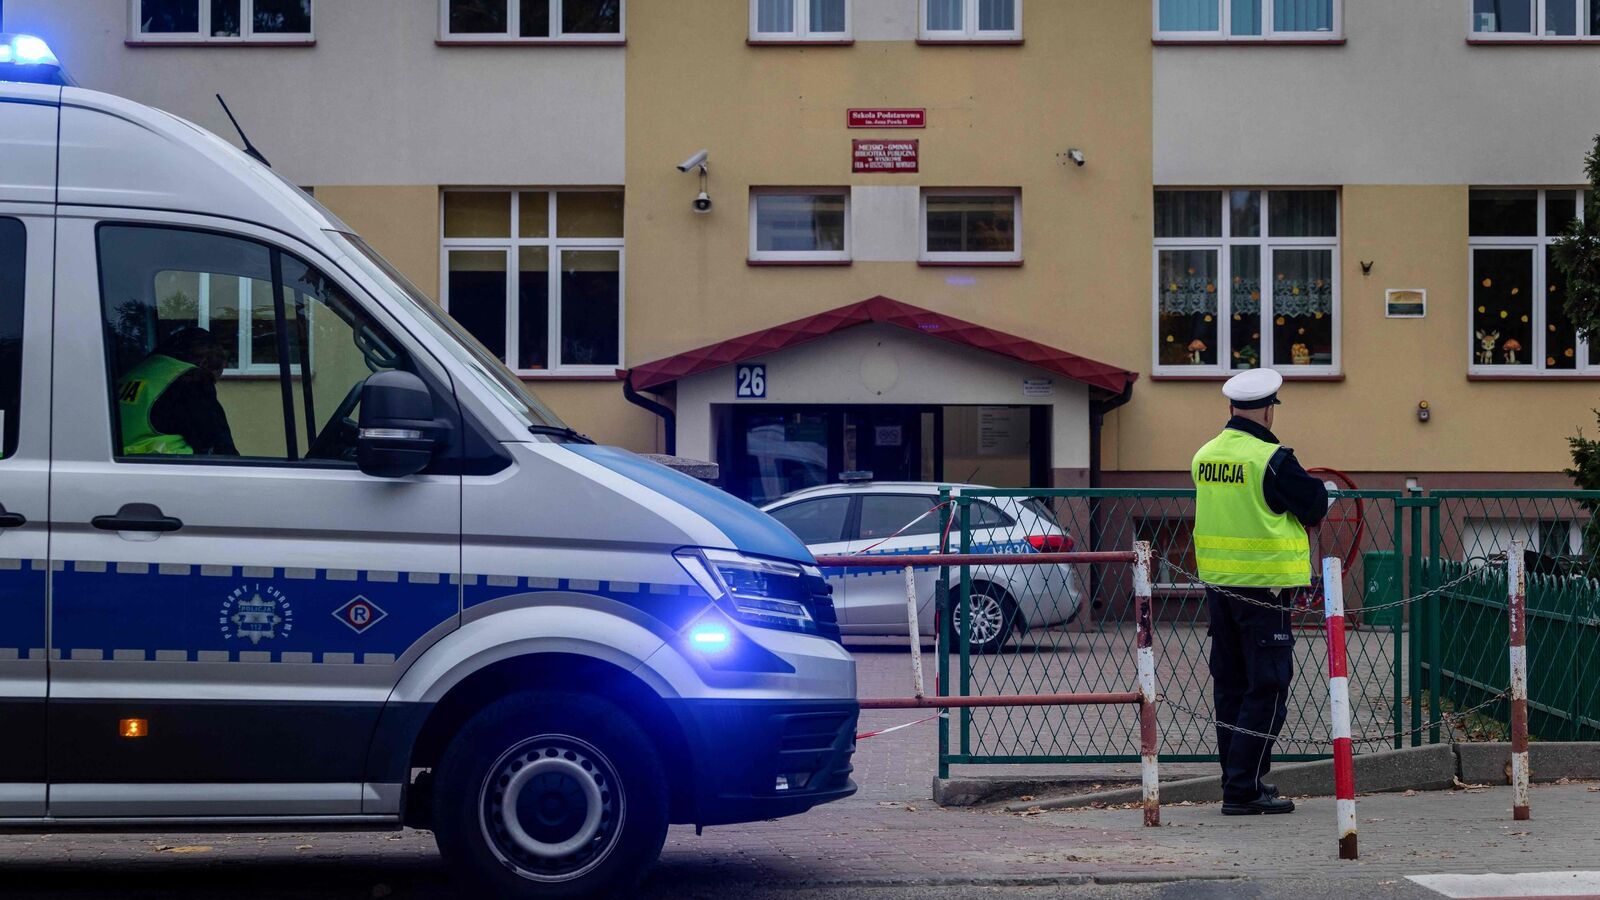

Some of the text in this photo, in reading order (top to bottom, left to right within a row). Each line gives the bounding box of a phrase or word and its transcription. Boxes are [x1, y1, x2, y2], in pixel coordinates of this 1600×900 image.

[877, 111, 920, 119] Podstawowa
[739, 367, 764, 396] 26
[1199, 463, 1244, 483] POLICJA
[220, 585, 247, 639] POMAGAMY
[267, 586, 293, 638] CHRONIMY
[354, 607, 366, 621] R
